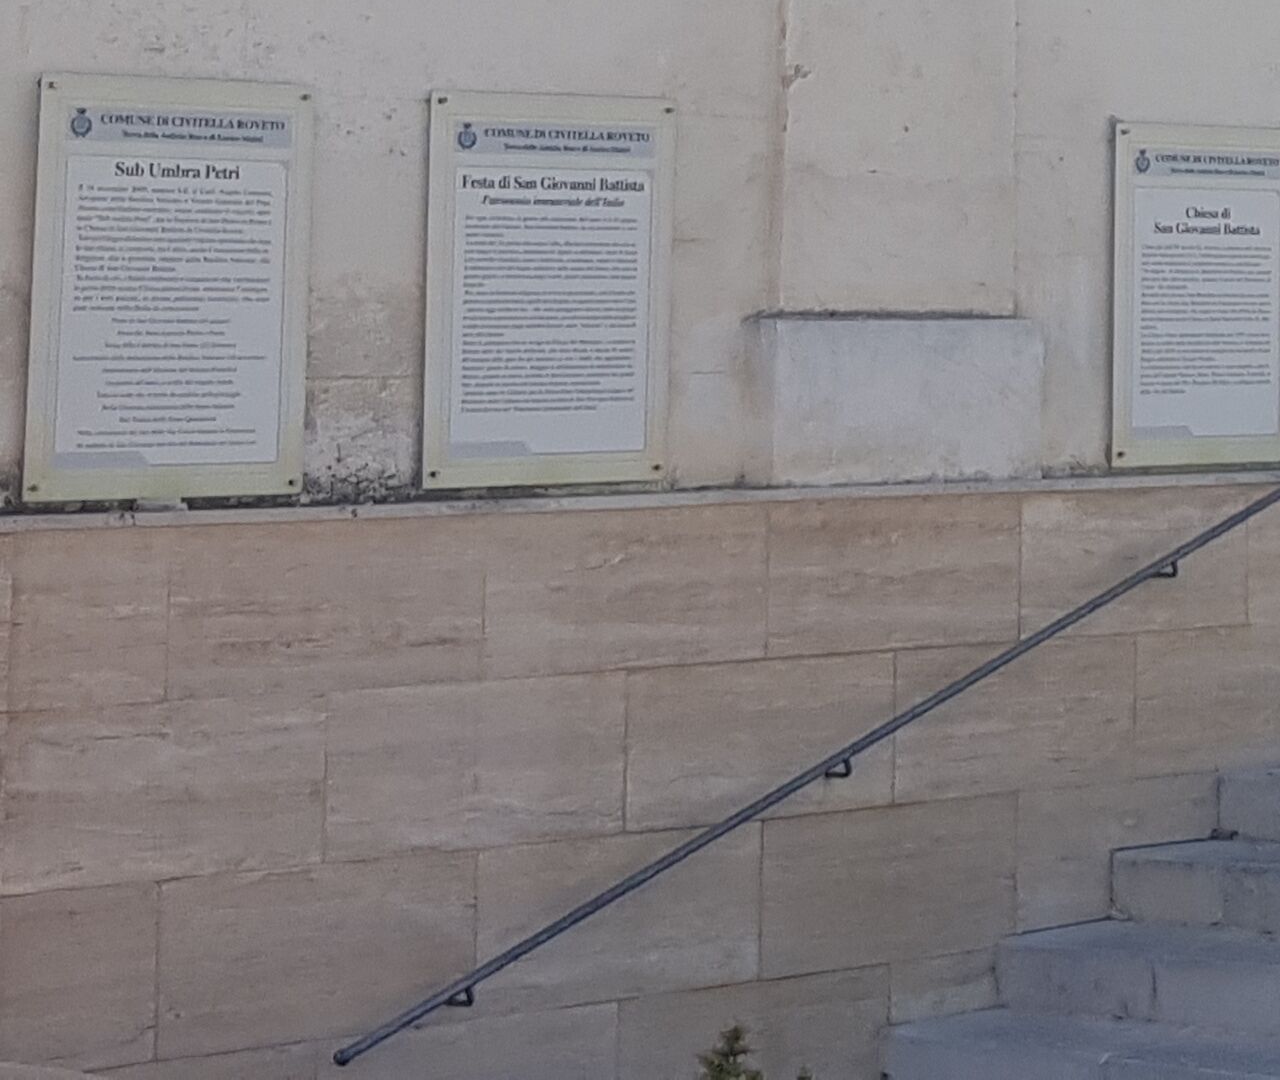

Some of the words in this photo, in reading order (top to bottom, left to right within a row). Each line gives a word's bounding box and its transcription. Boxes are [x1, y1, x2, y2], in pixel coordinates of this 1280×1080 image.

[100, 114, 152, 126] COMUNE
[172, 116, 235, 130] CIVITELLA
[236, 119, 285, 131] ROVETO
[484, 128, 533, 139] COMUNE
[549, 130, 605, 141] CIVITELLA
[607, 131, 650, 143] ROVETO
[114, 161, 144, 177] Sub
[150, 163, 201, 179] Umbra
[205, 164, 241, 180] Petri
[462, 175, 495, 189] Festa
[499, 175, 511, 189] di
[514, 176, 537, 190] San
[541, 176, 596, 191] Giovanni
[600, 178, 645, 192] Battista
[1185, 207, 1219, 219] Chiesa
[1221, 207, 1231, 219] di
[1154, 222, 1173, 234] San
[1176, 222, 1220, 235] Giovanni
[1224, 223, 1260, 236] Battista
